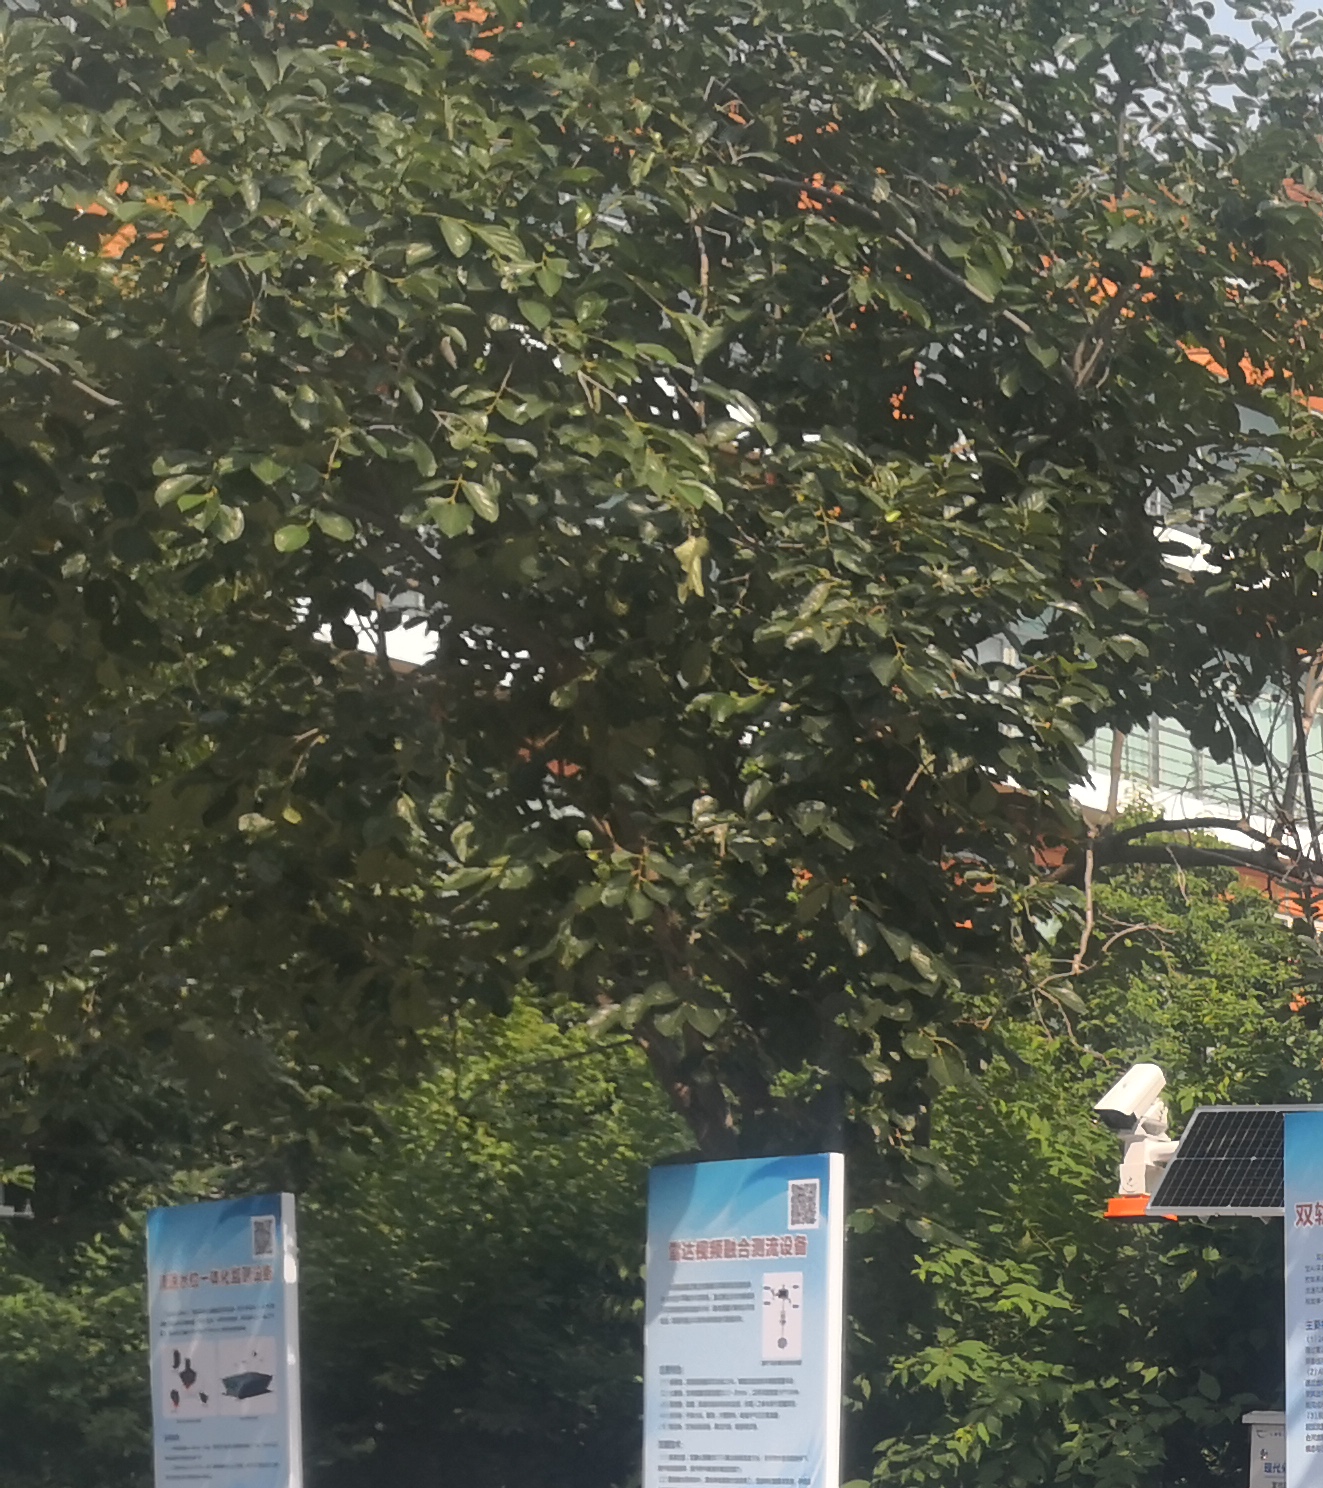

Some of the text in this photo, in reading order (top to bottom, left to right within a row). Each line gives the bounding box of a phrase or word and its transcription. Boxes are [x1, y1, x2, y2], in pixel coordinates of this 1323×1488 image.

[669, 1235, 807, 1261] 雷达视频融合测流设备
